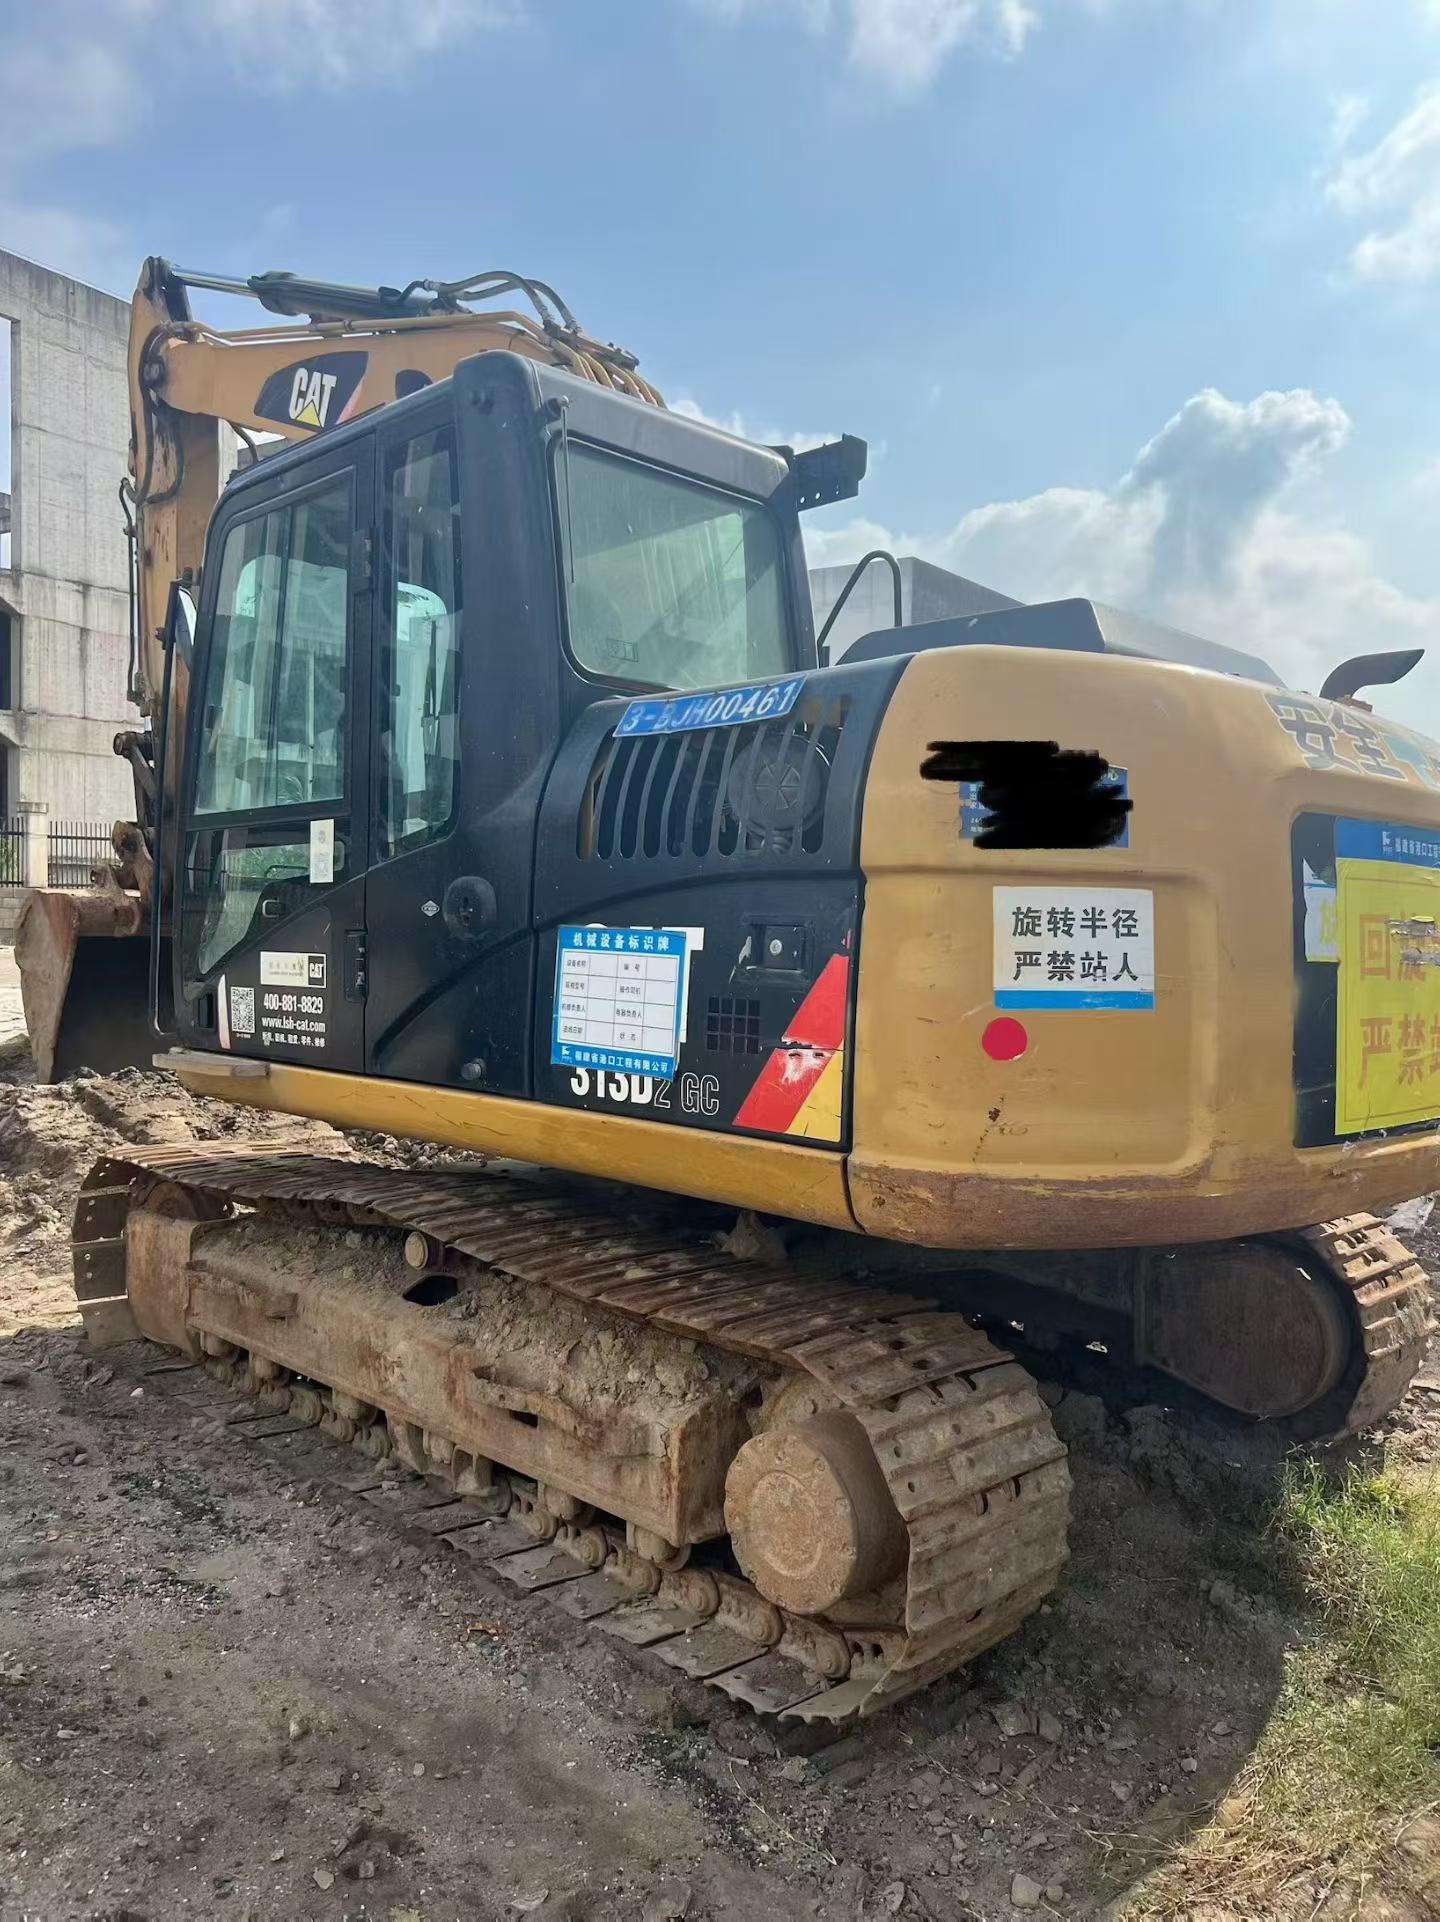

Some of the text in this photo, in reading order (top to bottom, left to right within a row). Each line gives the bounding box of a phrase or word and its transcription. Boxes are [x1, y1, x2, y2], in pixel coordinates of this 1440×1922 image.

[288, 367, 338, 428] CAT
[1012, 906, 1139, 938] 旋转半径
[573, 932, 670, 951] 机械设备标识牌
[309, 962, 324, 978] CAT
[1012, 950, 1139, 982] 严禁站人
[263, 993, 323, 1014] 400-881-8829
[261, 1015, 326, 1033] www.lsh-cat.com
[574, 1051, 669, 1073] 福建省港口工程有限公司
[681, 1072, 720, 1116] GC
